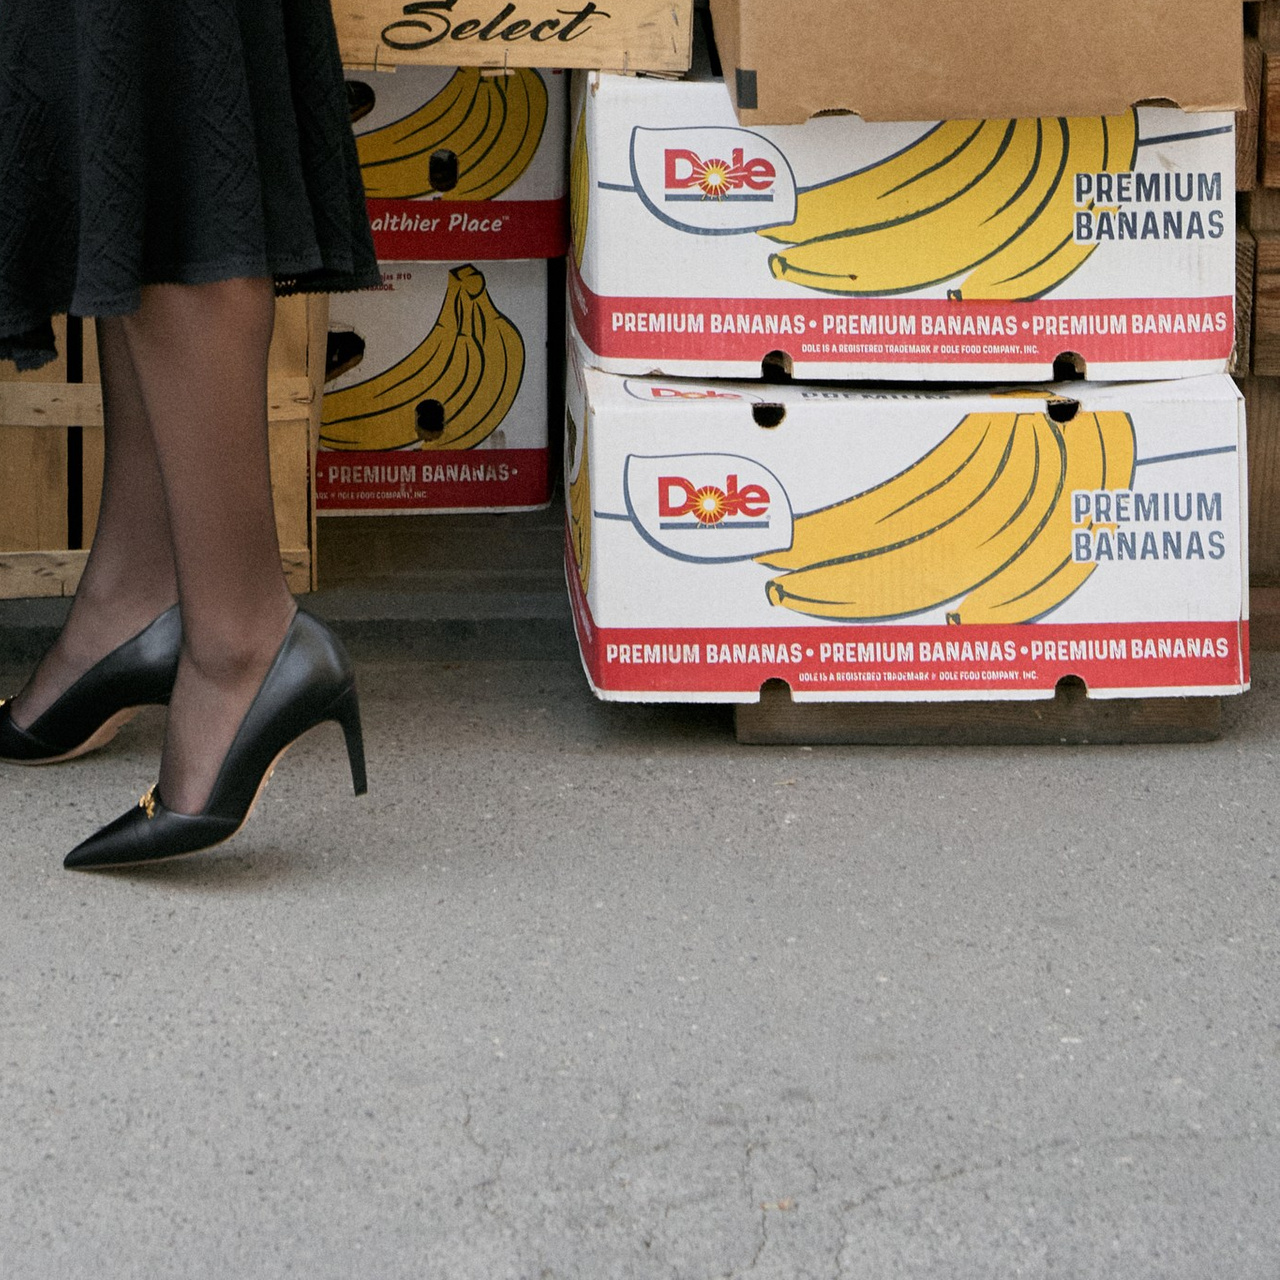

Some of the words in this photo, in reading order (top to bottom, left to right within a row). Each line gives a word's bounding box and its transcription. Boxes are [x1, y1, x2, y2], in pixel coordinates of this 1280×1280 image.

[664, 147, 777, 197] Dole
[1075, 172, 1223, 203] PREMIUM
[370, 213, 440, 232] althier
[1075, 209, 1226, 241] BANANAS
[611, 311, 705, 334] PREMIUM
[710, 313, 807, 335] BANANAS
[822, 314, 916, 336] PREMIUM
[921, 314, 1018, 336] BANANAS
[1032, 313, 1129, 336] PREMIUM
[1131, 310, 1228, 333] BANANAS
[802, 343, 820, 354] DOLE
[838, 343, 884, 354] REGISTERED
[885, 343, 931, 354] TRADEMARK
[941, 343, 959, 354] DOLE
[960, 343, 980, 354] FOOD
[328, 464, 417, 484] PREMIUM
[422, 462, 510, 483] BANANAS
[658, 474, 771, 525] Dole
[1074, 491, 1223, 523] PREMIUM
[1074, 530, 1226, 562] BANANAS
[606, 643, 700, 665] PREMIUM
[705, 642, 802, 664] BANANAS
[819, 641, 915, 663] PREMIUM
[919, 641, 1017, 663] BANANAS
[1031, 639, 1128, 662] PREMIUM
[1131, 637, 1229, 660] BANANAS
